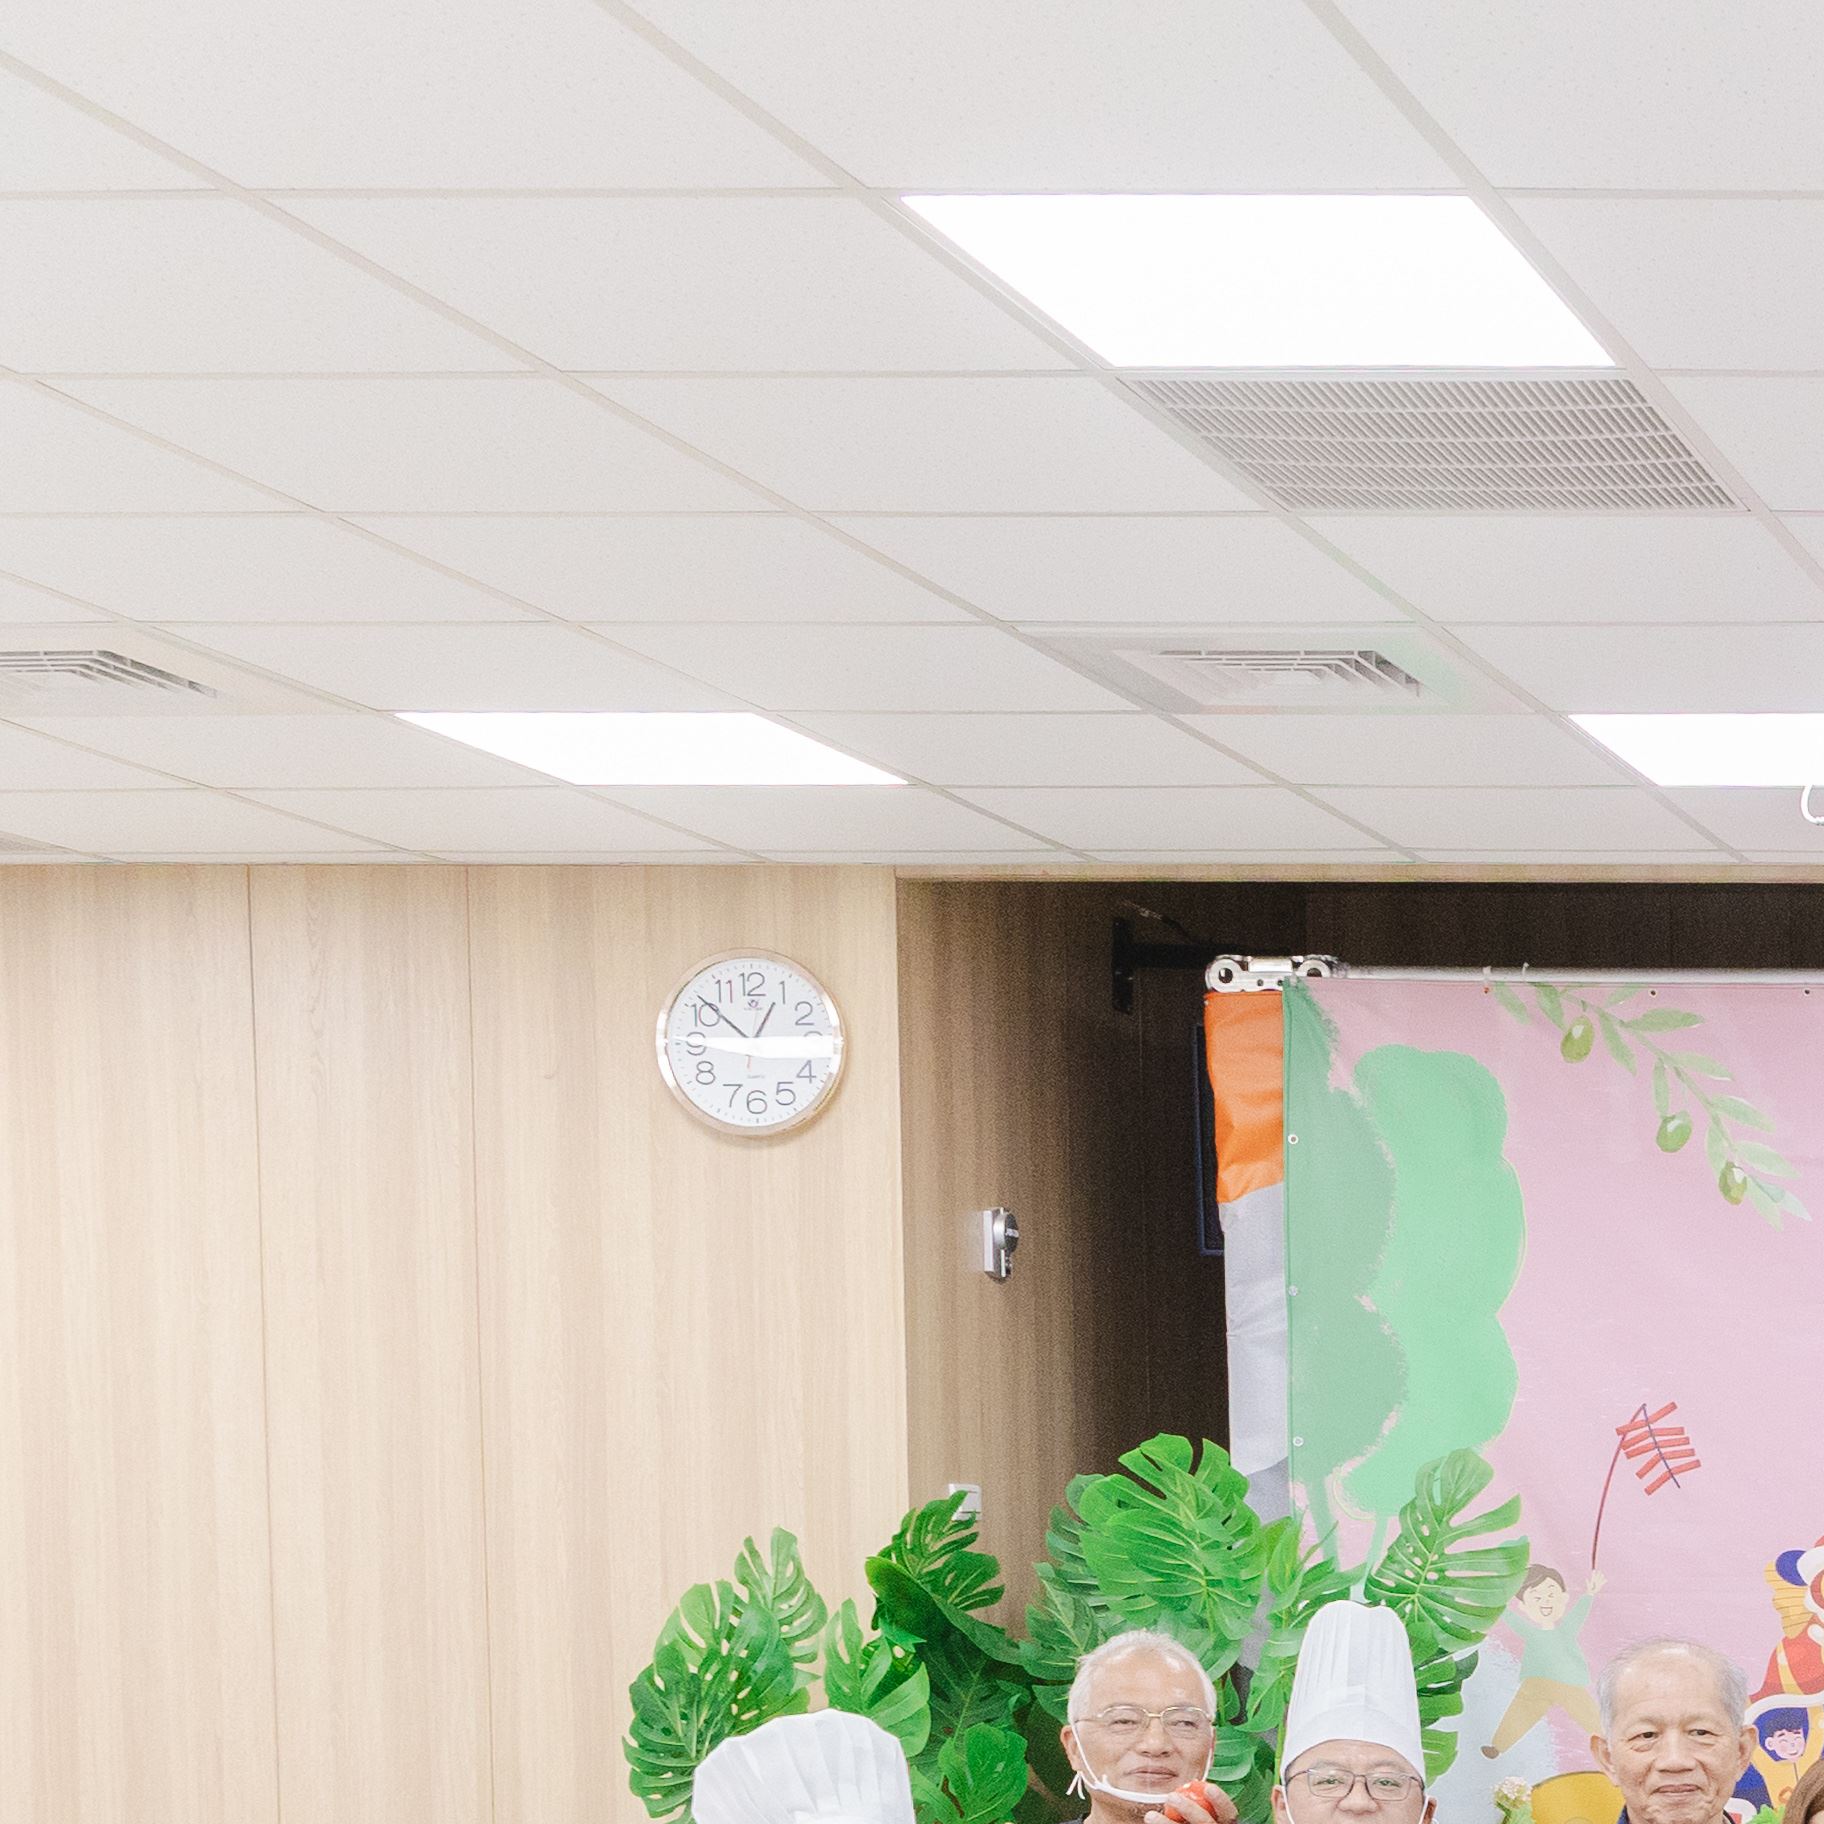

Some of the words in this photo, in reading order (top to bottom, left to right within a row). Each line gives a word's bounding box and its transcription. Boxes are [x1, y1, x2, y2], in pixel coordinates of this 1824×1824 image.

[715, 980, 733, 1003] 11
[740, 972, 766, 996] 12
[779, 981, 786, 1004] 1
[795, 1001, 815, 1025] 2
[696, 1061, 716, 1085] 8
[796, 1060, 817, 1084] 4
[723, 1084, 743, 1108] 7
[747, 1090, 767, 1114] 6
[776, 1082, 796, 1106] 5
